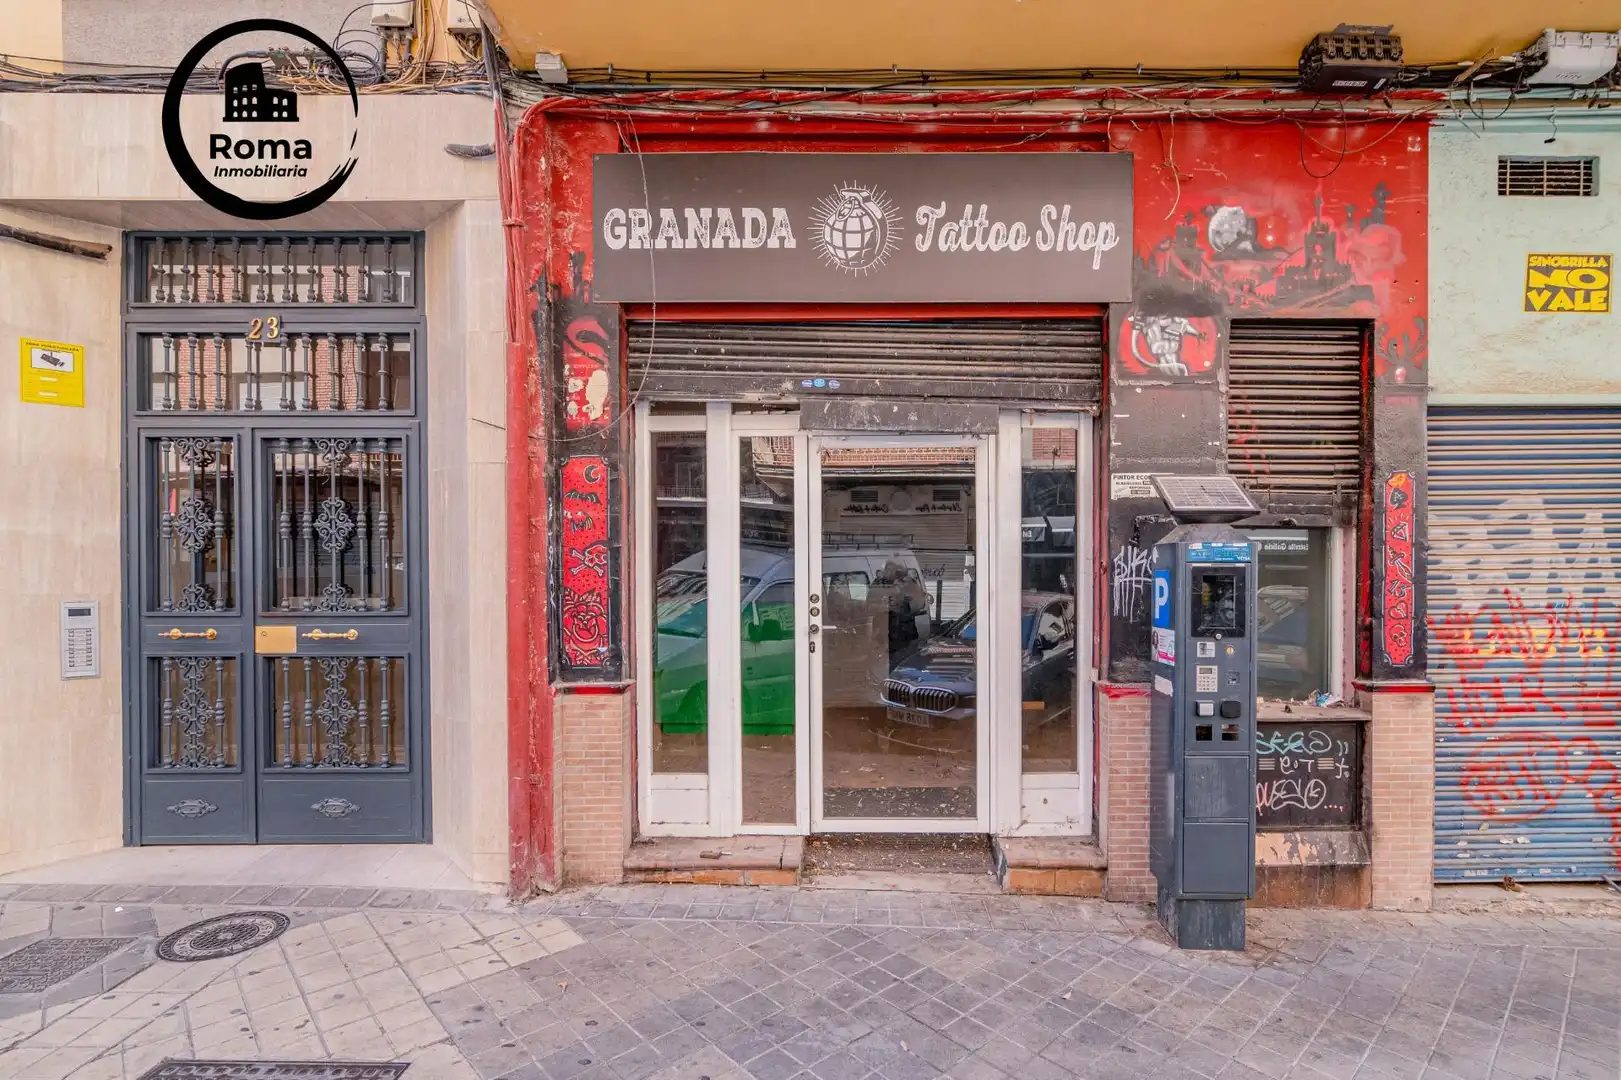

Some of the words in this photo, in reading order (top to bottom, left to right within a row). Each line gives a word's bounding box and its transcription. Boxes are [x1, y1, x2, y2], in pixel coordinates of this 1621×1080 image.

[603, 207, 797, 250] GRANADA
[915, 201, 1031, 252] Tattoo
[1036, 204, 1120, 270] Shop
[1529, 268, 1608, 289] NO
[1527, 289, 1607, 311] VALE
[248, 316, 279, 340] 23
[1154, 577, 1169, 619] P
